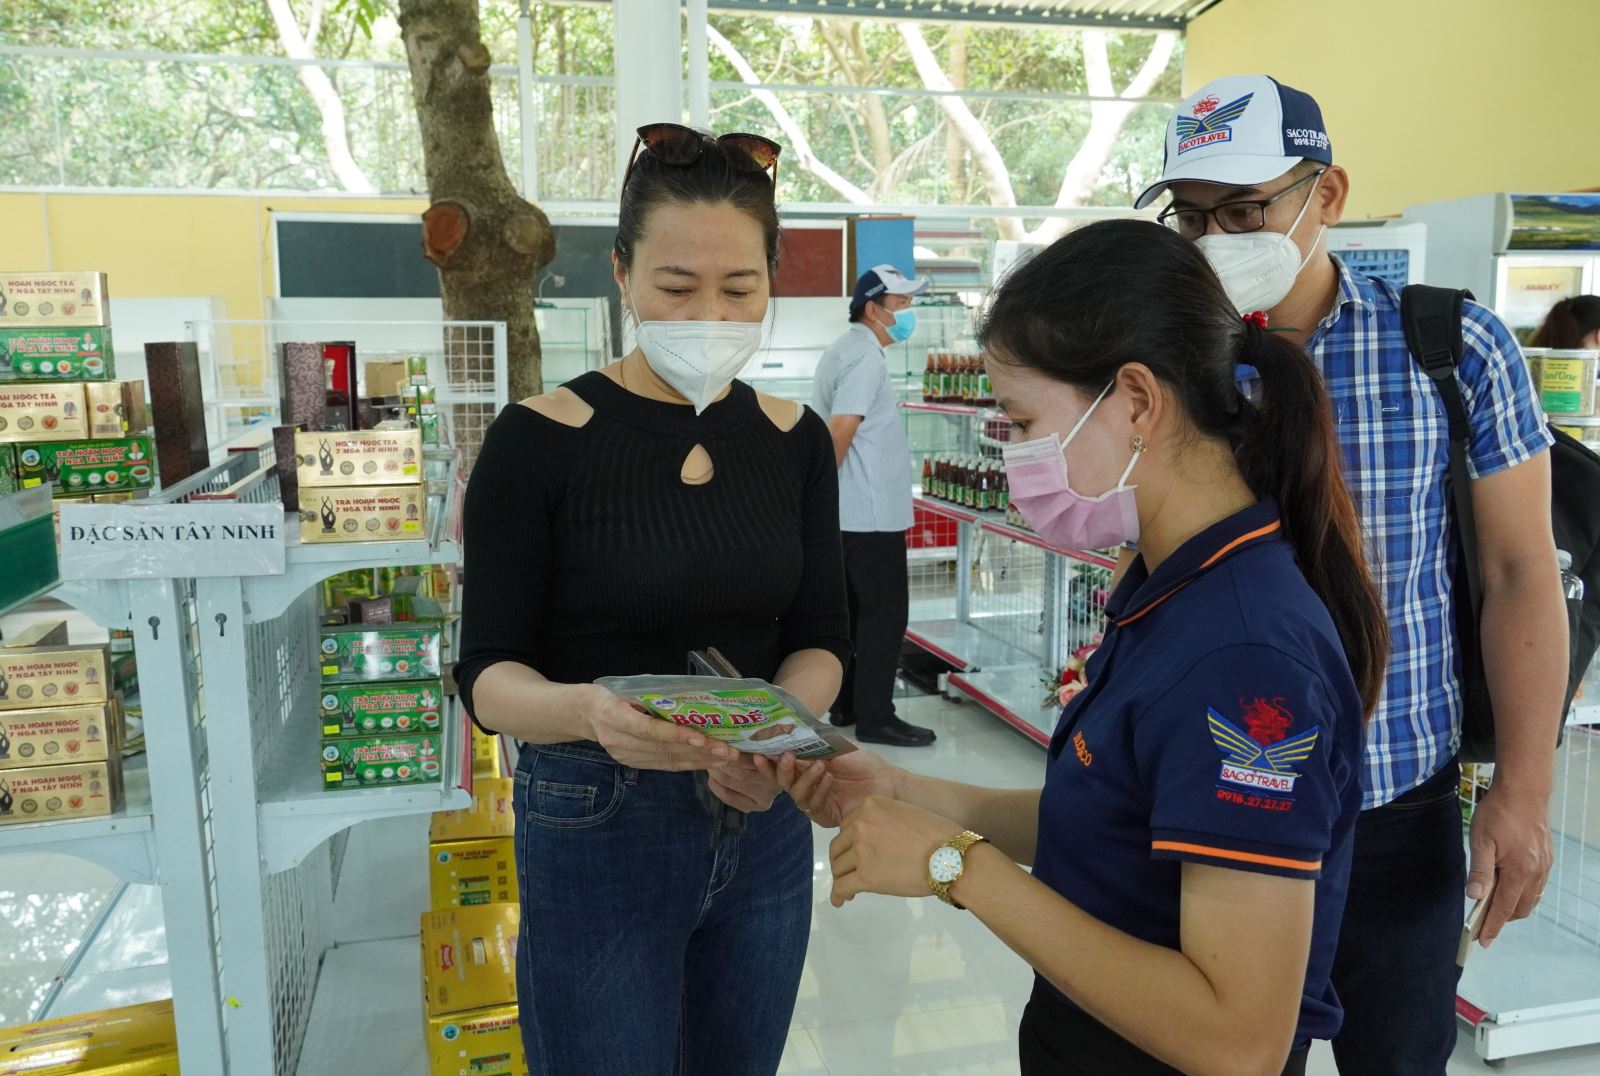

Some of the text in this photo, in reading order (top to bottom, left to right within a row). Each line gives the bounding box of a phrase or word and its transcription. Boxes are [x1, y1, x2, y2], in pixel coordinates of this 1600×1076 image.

[1179, 131, 1228, 151] SACOTRAVEL
[70, 523, 116, 545] ĐẶC
[122, 521, 165, 541] SẢN
[171, 521, 216, 540] TÂY
[221, 524, 275, 540] NINH
[671, 709, 768, 728] BỘT DẾ
[1222, 768, 1291, 790] SACOTRAVEL
